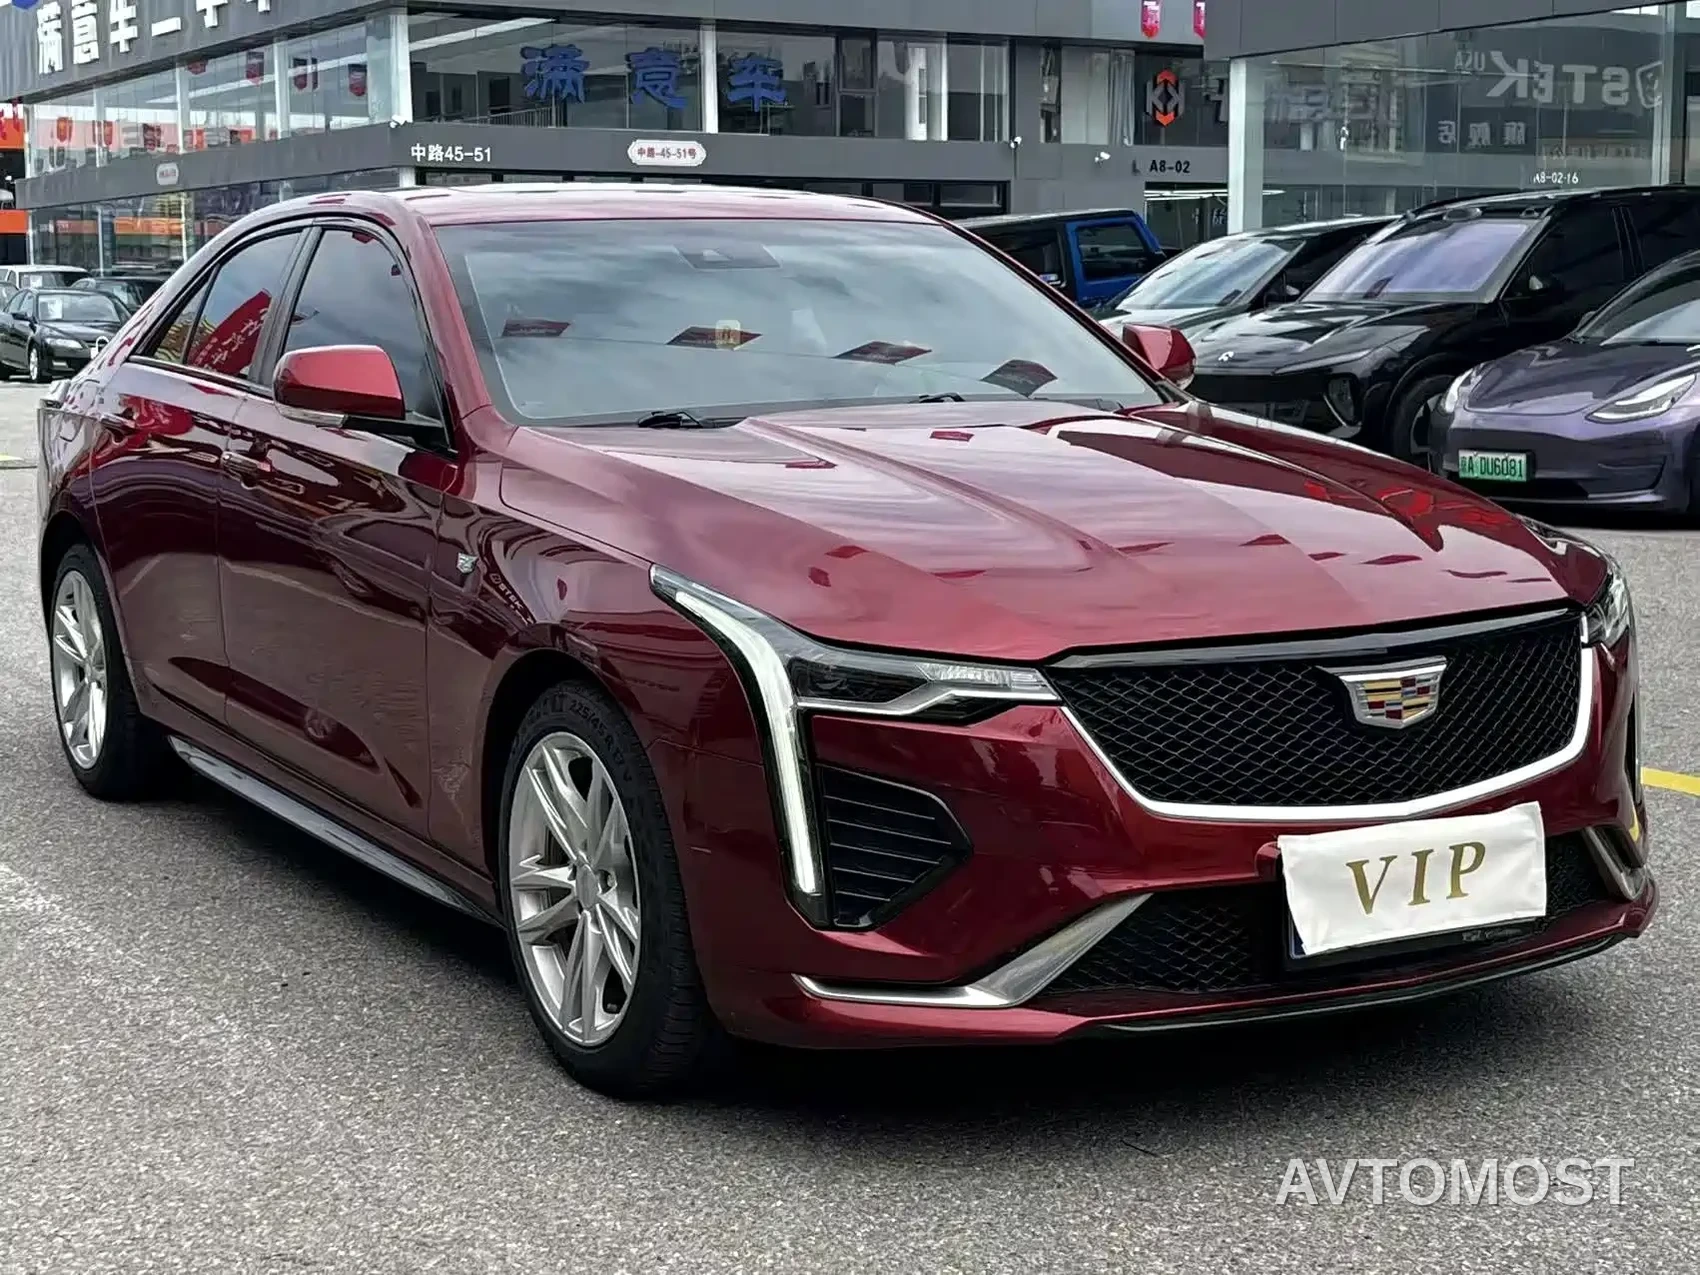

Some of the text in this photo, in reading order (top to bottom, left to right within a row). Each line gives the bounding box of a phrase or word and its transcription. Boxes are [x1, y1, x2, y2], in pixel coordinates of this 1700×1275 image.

[520, 44, 787, 113] 满意车
[410, 143, 492, 163] 中路45-51
[1149, 159, 1190, 174] A8-02
[1345, 840, 1486, 915] VIP
